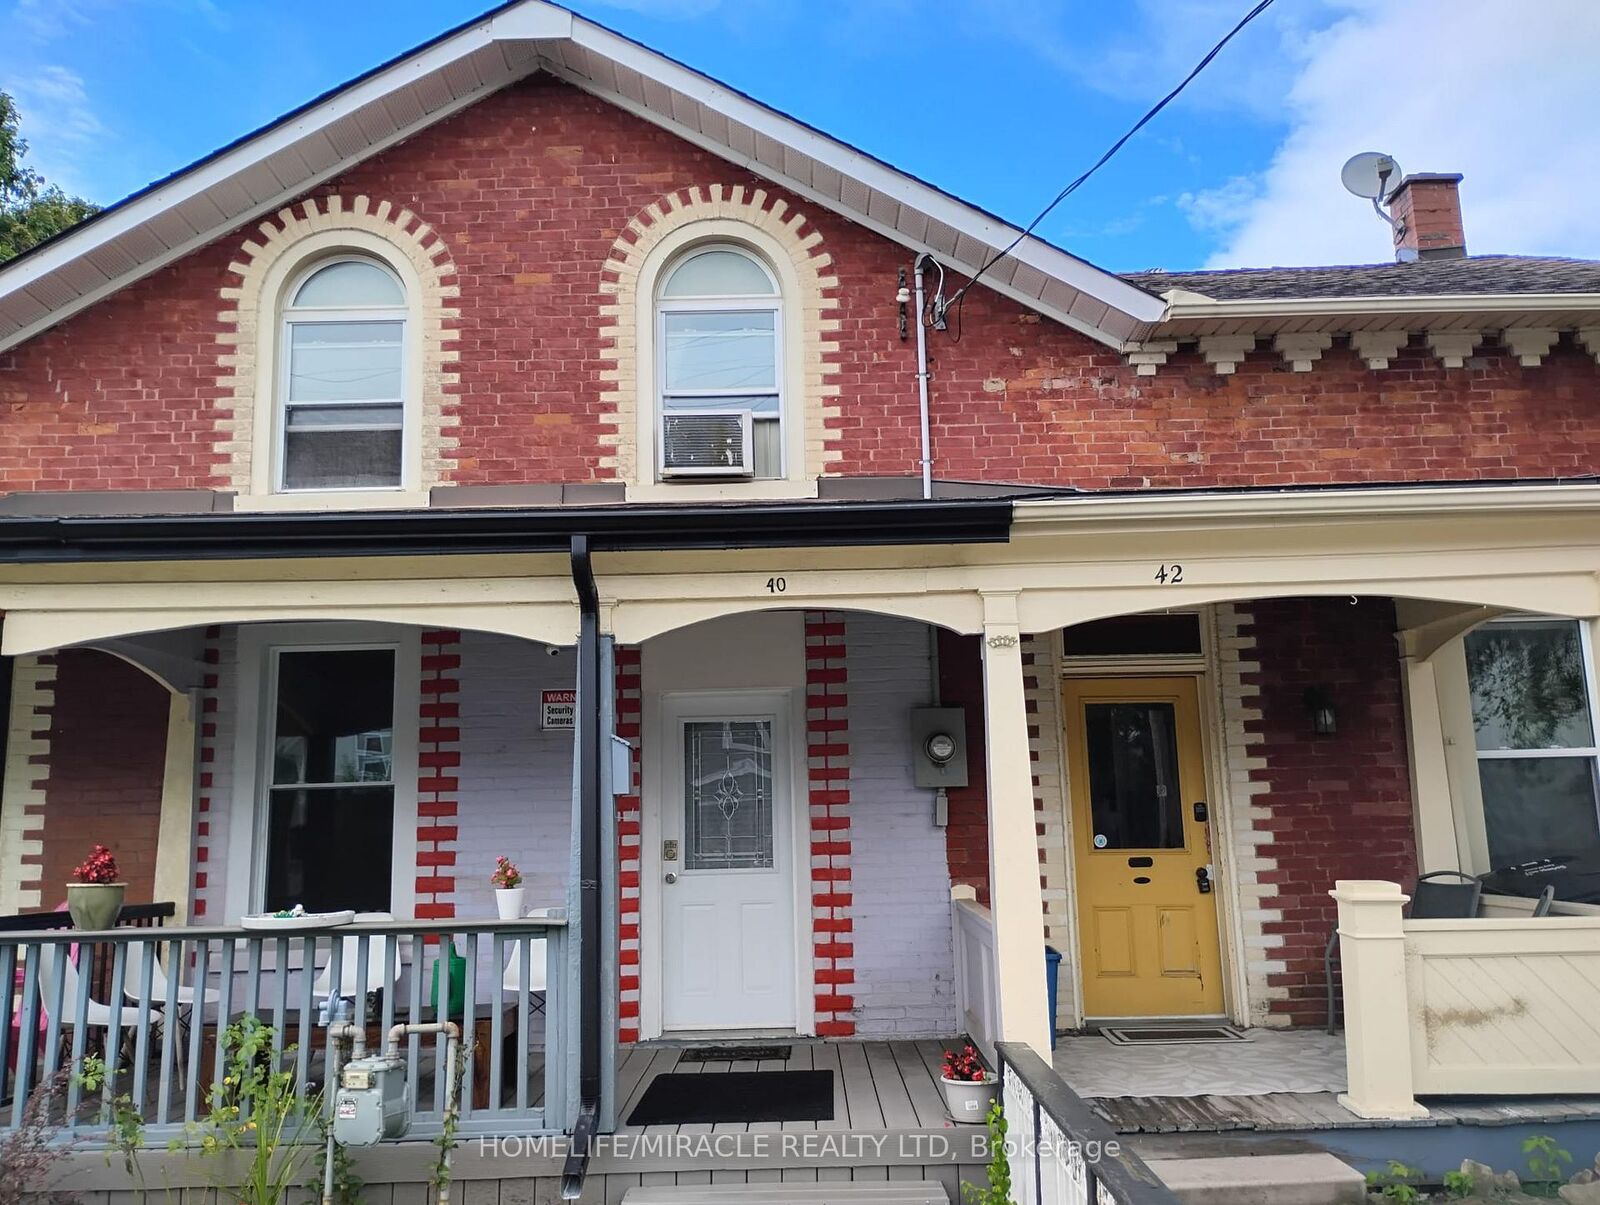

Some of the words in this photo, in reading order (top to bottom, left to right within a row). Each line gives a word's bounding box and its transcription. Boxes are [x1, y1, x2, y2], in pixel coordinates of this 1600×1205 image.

[1154, 564, 1183, 584] 42
[766, 577, 786, 593] 40
[546, 705, 574, 716] Security
[546, 716, 573, 725] Cameras
